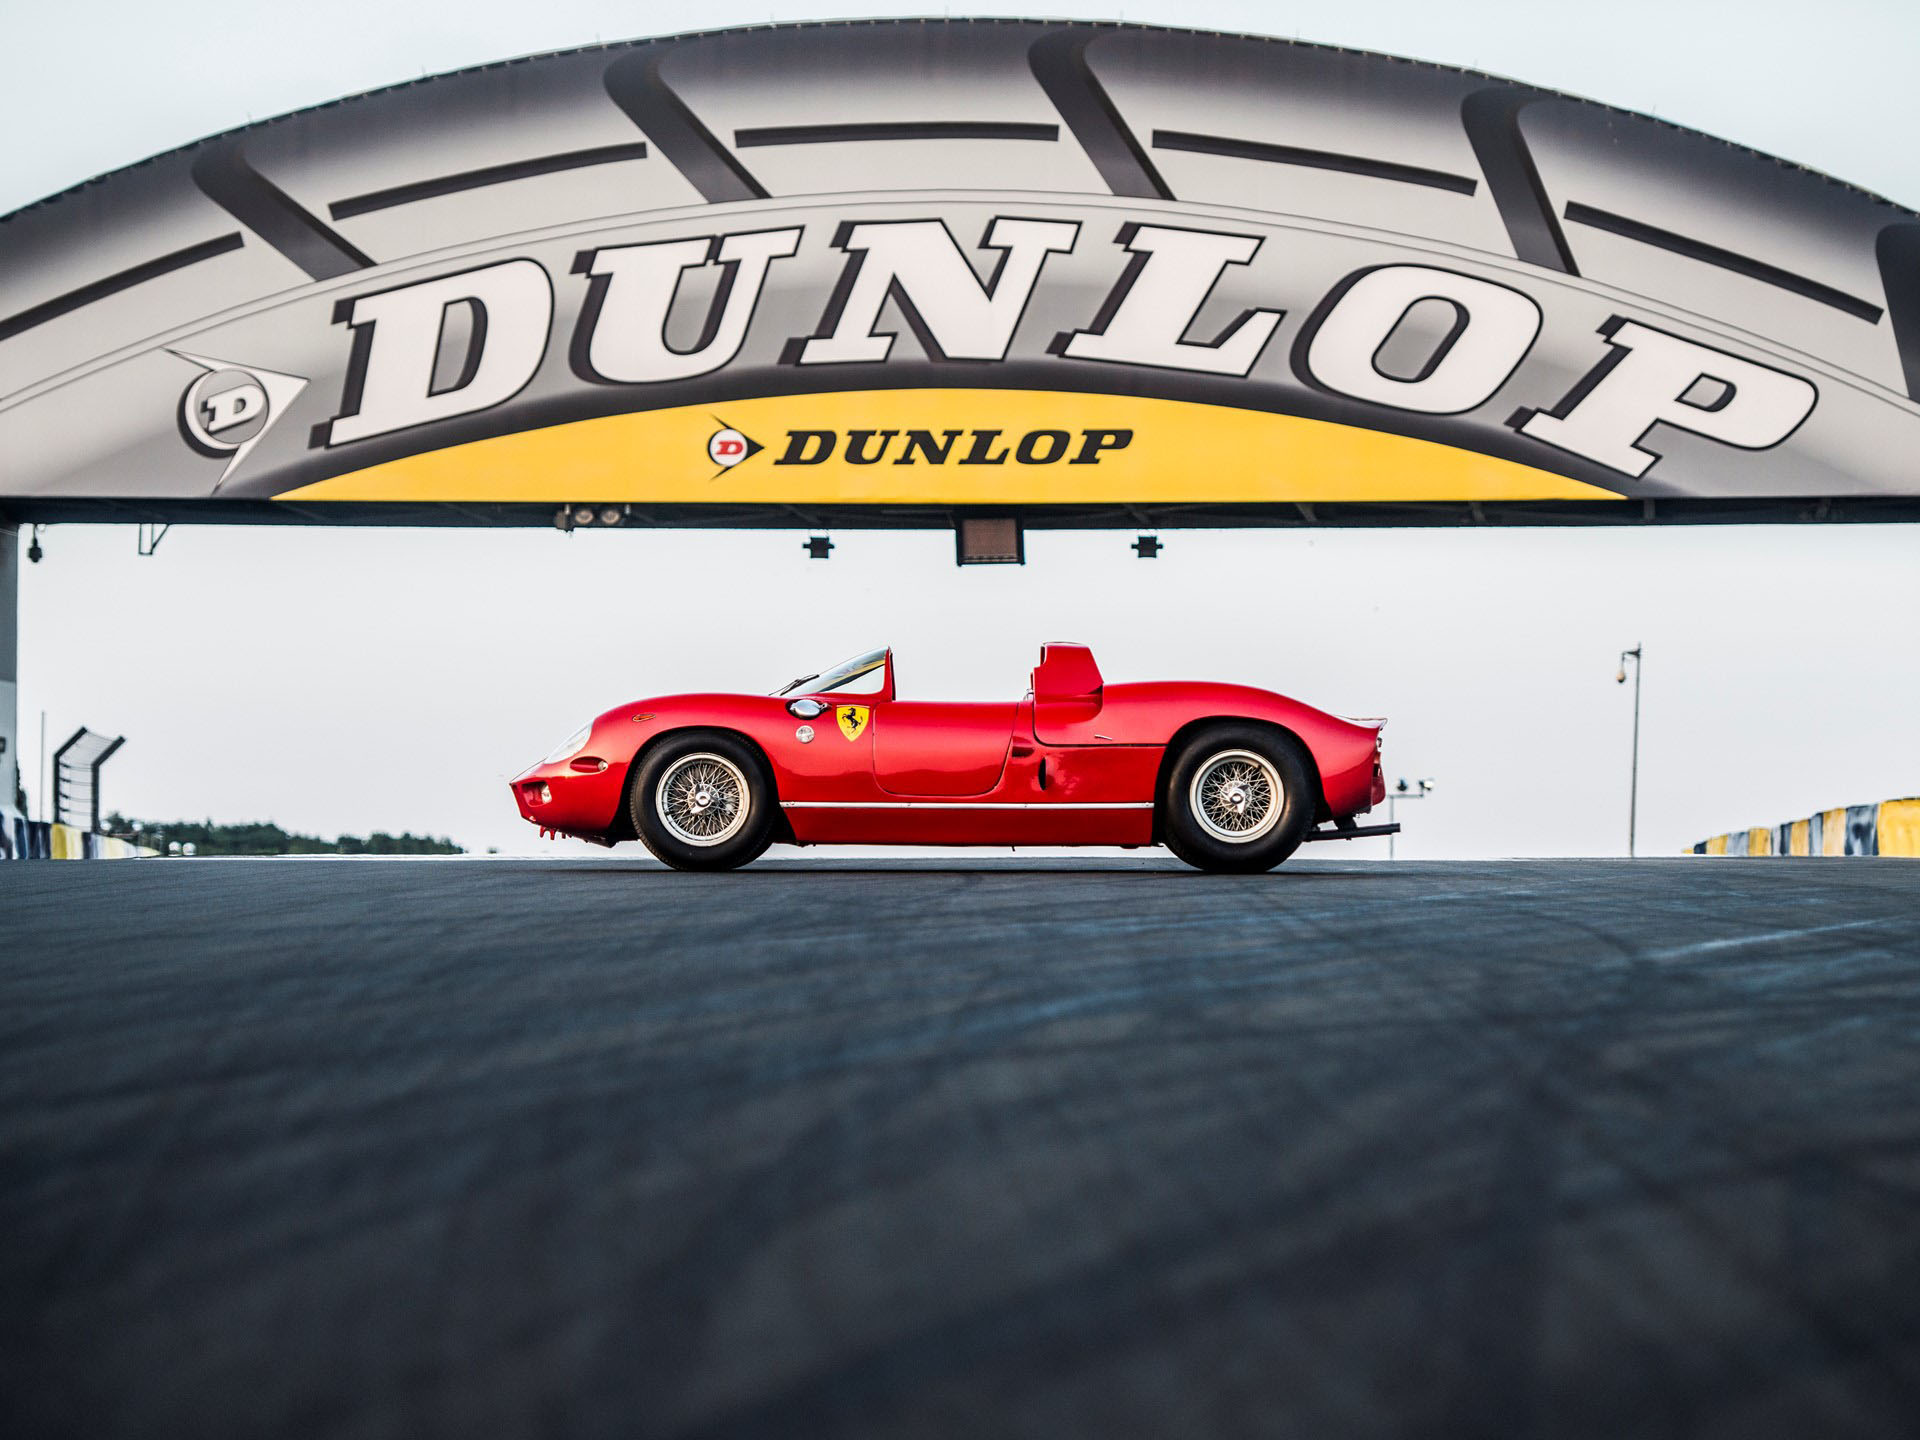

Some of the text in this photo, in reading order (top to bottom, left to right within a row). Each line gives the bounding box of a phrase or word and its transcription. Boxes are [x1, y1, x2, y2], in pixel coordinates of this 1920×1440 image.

[204, 216, 1820, 480] D DUNLOP
[716, 429, 1134, 466] D DUNLOP
